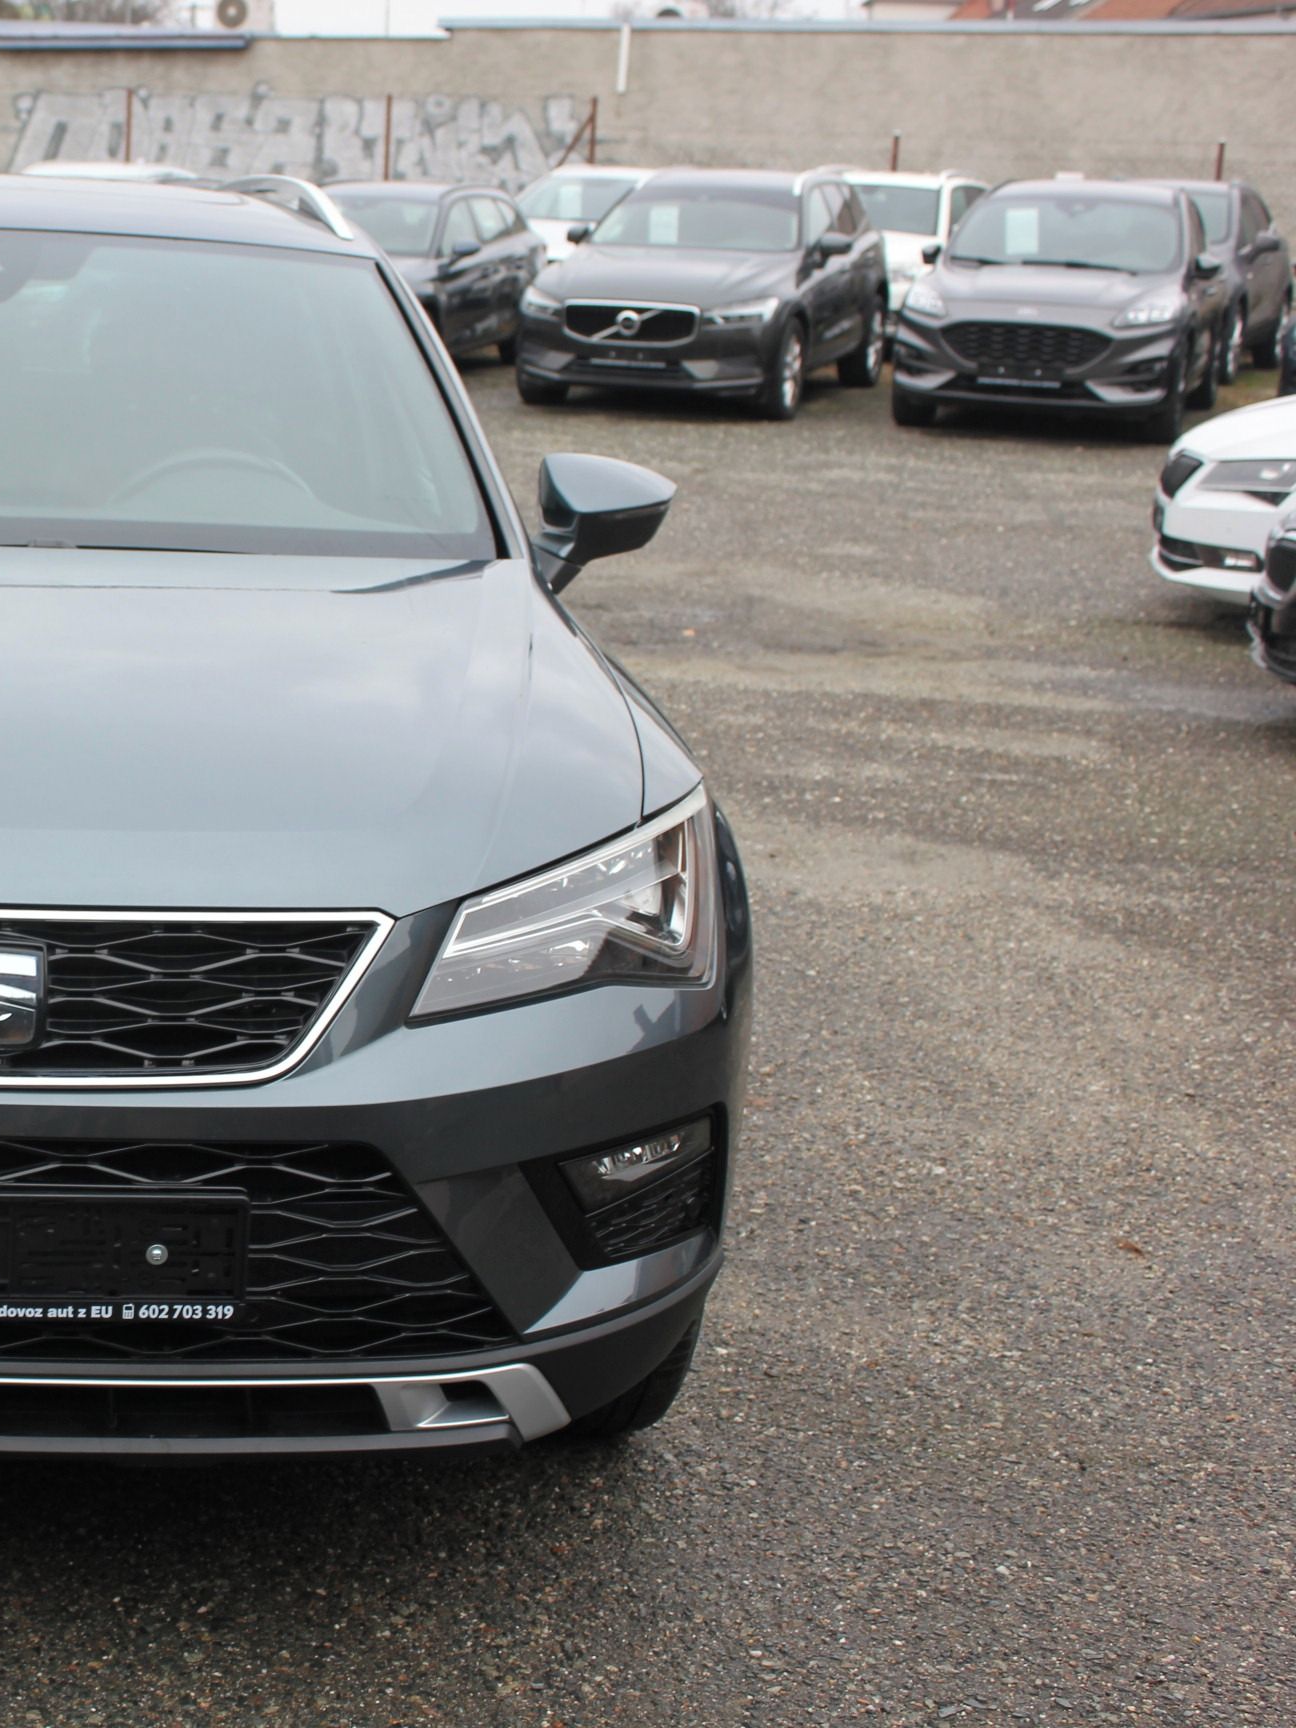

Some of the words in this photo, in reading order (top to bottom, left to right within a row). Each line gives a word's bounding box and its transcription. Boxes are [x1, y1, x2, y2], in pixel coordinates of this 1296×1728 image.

[46, 1305, 74, 1318] aut
[77, 1307, 87, 1318] z
[90, 1305, 113, 1319] EU
[138, 1304, 170, 1319] 602
[172, 1304, 203, 1319] 703
[205, 1304, 234, 1319] 319
